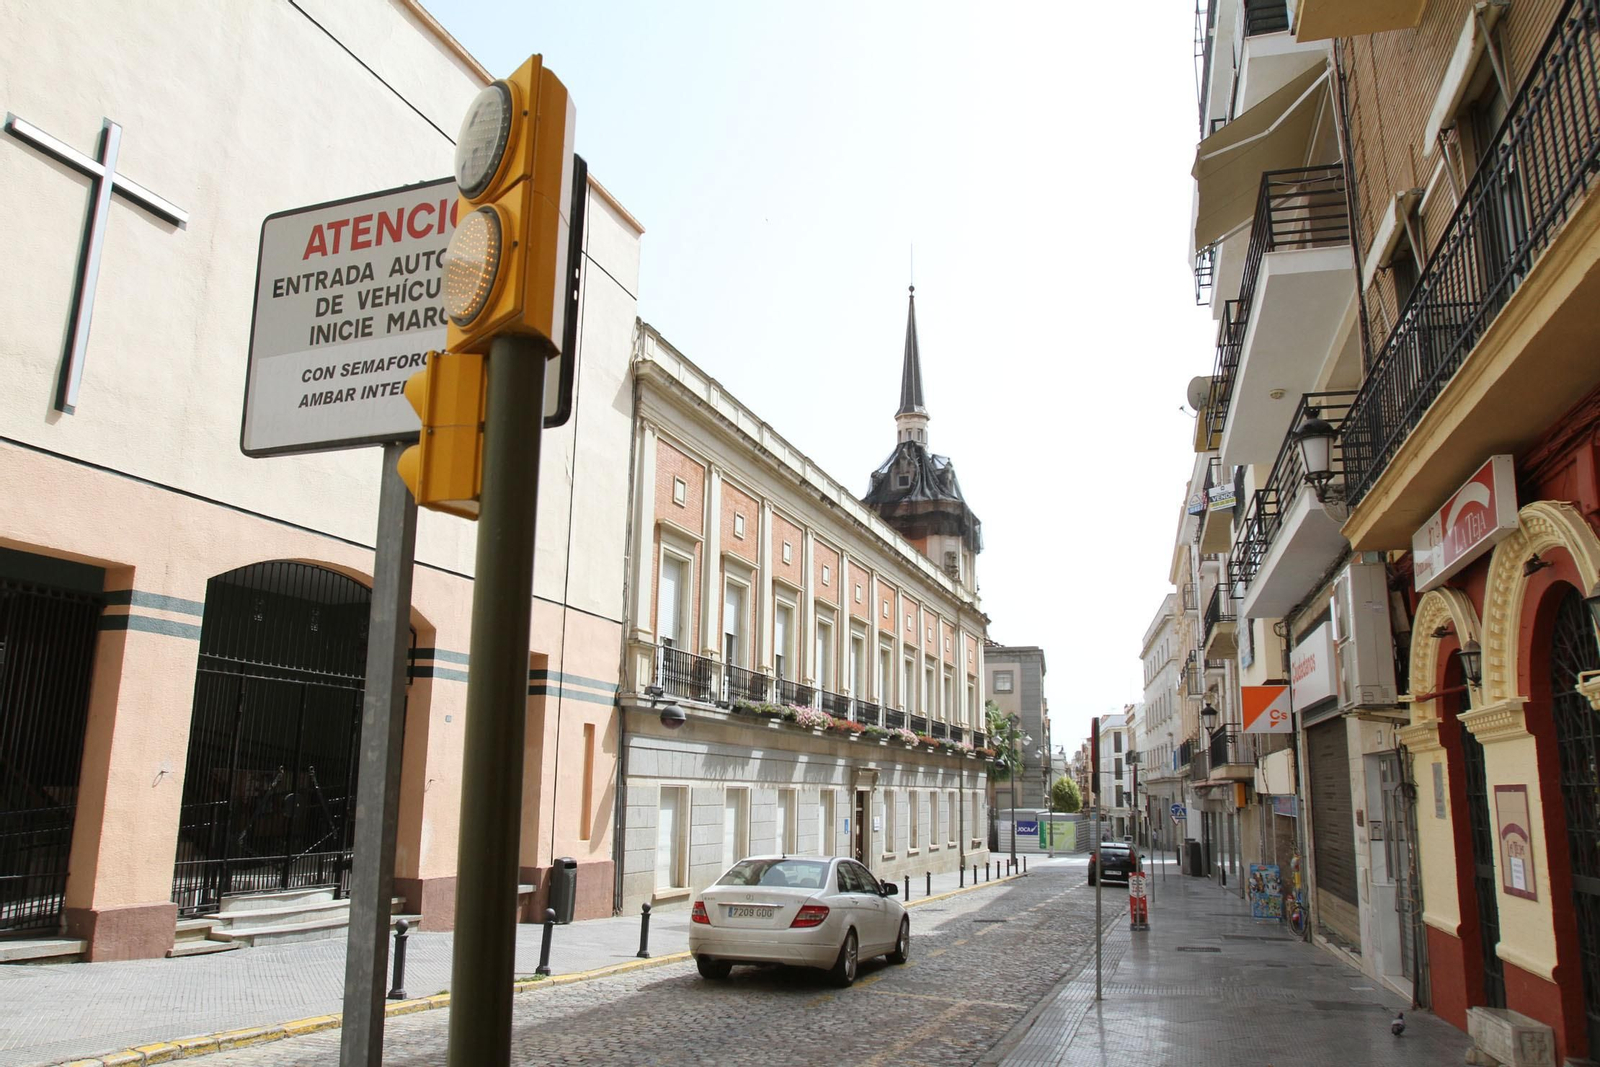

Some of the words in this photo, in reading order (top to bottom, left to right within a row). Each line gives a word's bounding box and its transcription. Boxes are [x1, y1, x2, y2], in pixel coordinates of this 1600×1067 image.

[272, 262, 374, 298] ENTRADA
[315, 294, 344, 317] DE
[309, 316, 374, 346] INICIE
[301, 365, 336, 383] CON
[298, 387, 356, 408] AMBAR
[1465, 510, 1487, 543] TEJA
[1270, 709, 1288, 720] Cs
[733, 907, 754, 917] 7209
